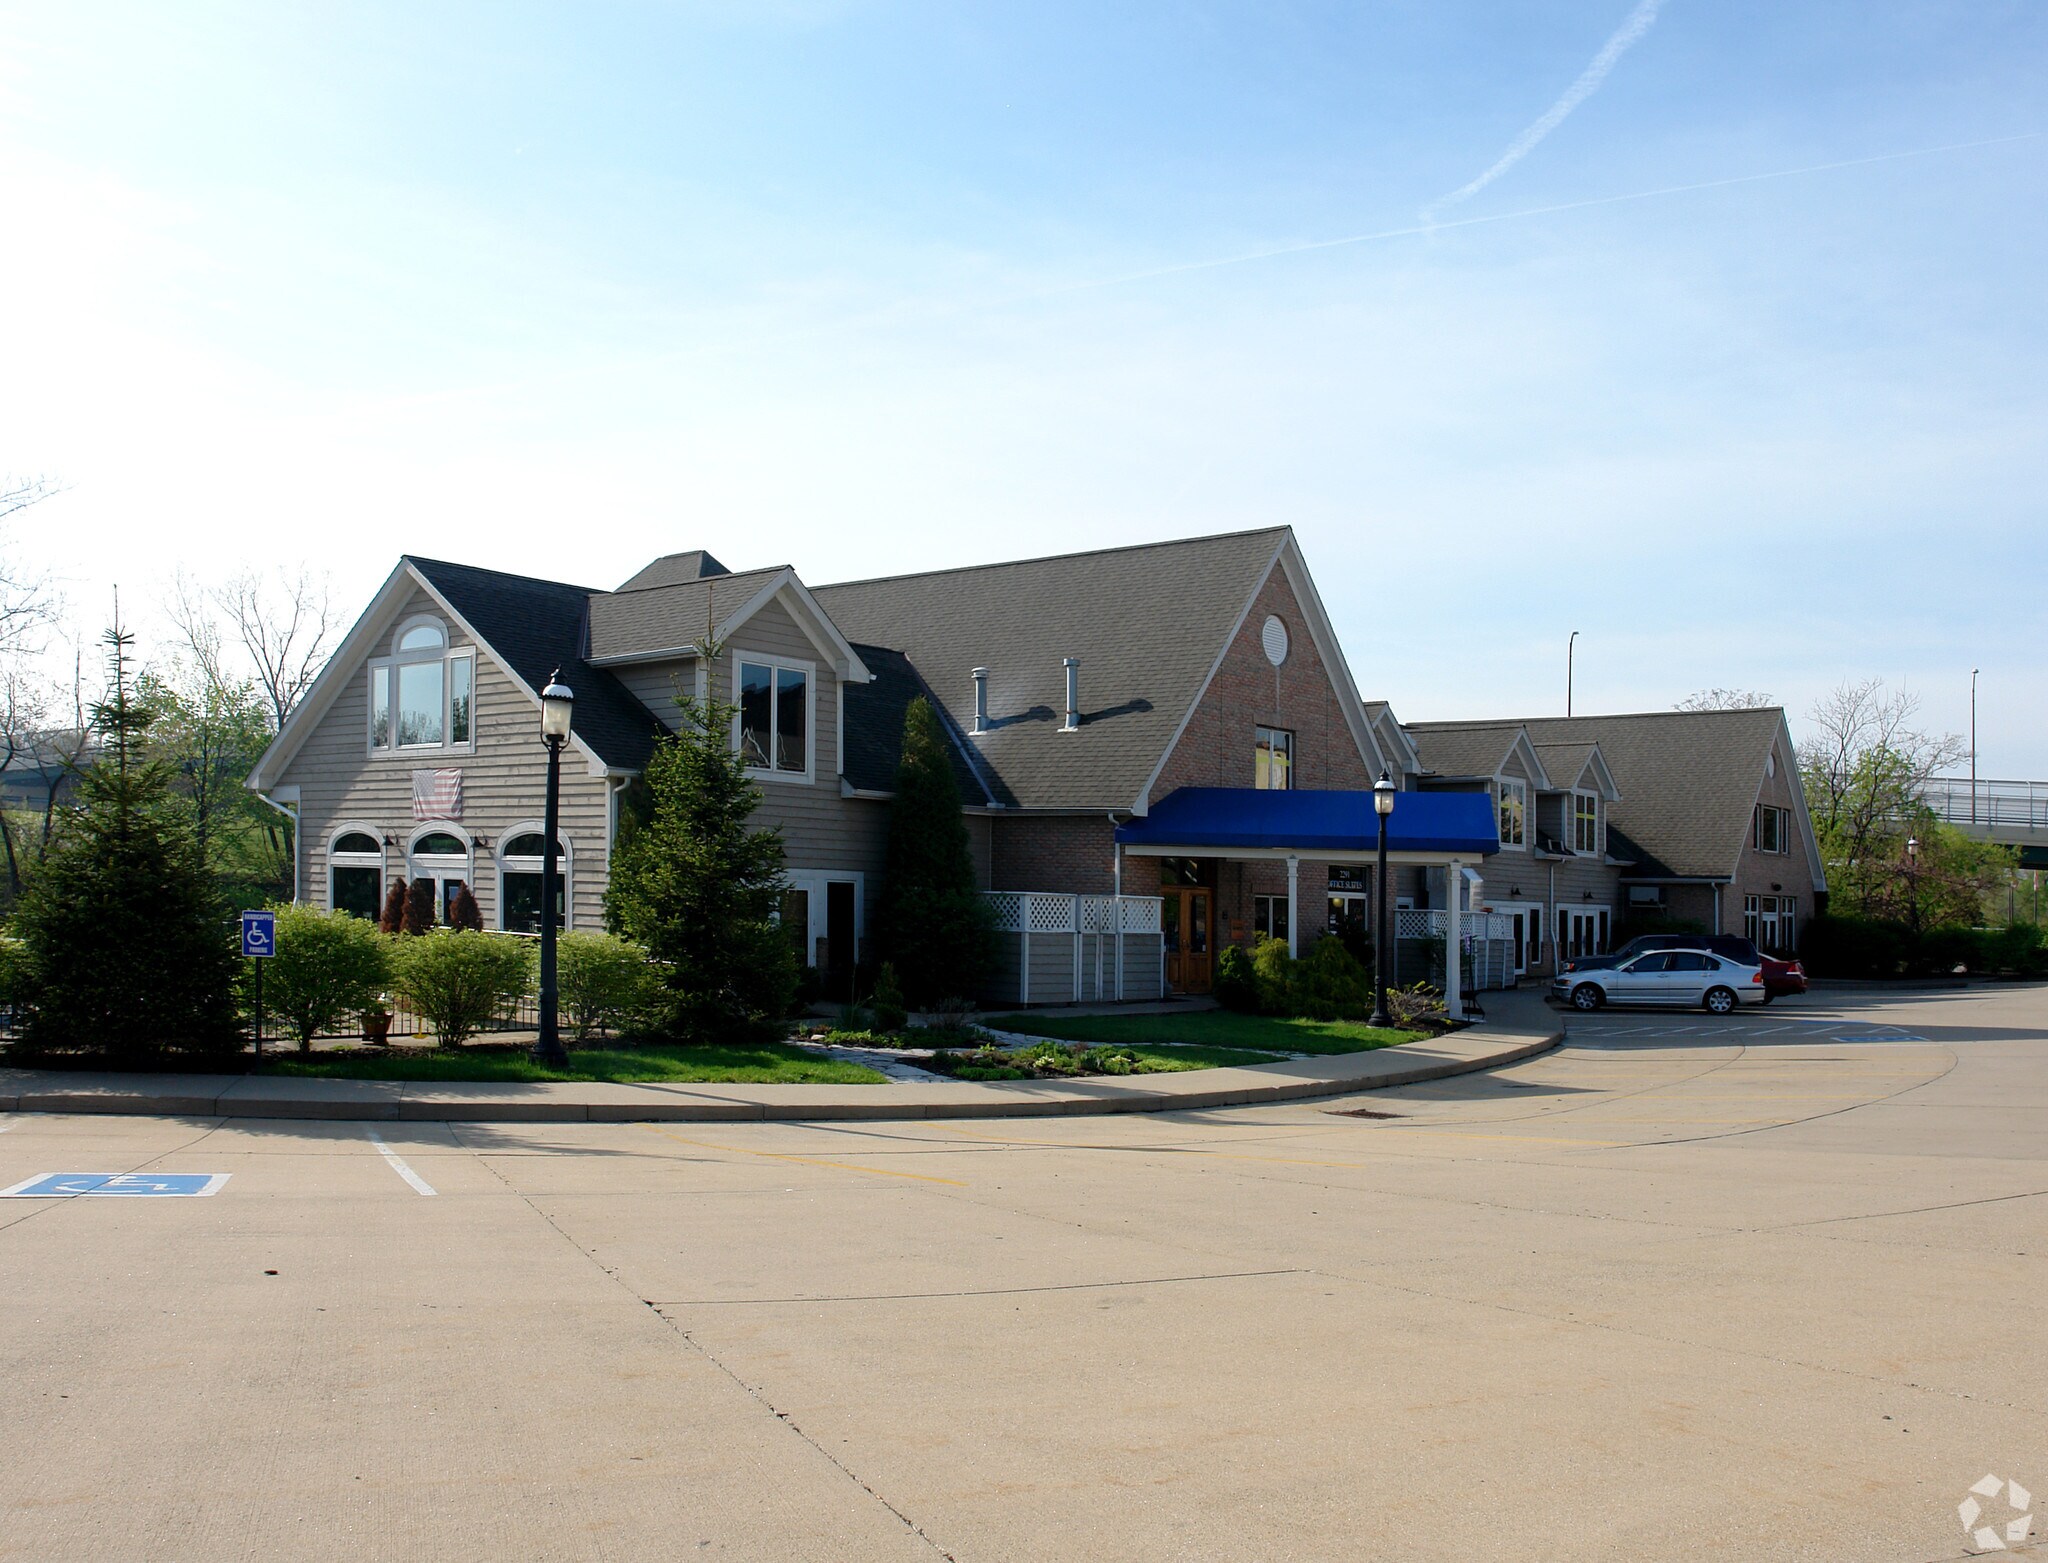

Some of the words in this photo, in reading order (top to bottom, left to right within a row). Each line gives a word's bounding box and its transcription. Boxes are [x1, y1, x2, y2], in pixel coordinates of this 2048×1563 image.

[1345, 881, 1363, 889] SUITES
[244, 913, 273, 921] HANDICAPPED
[249, 946, 268, 954] PARKING
